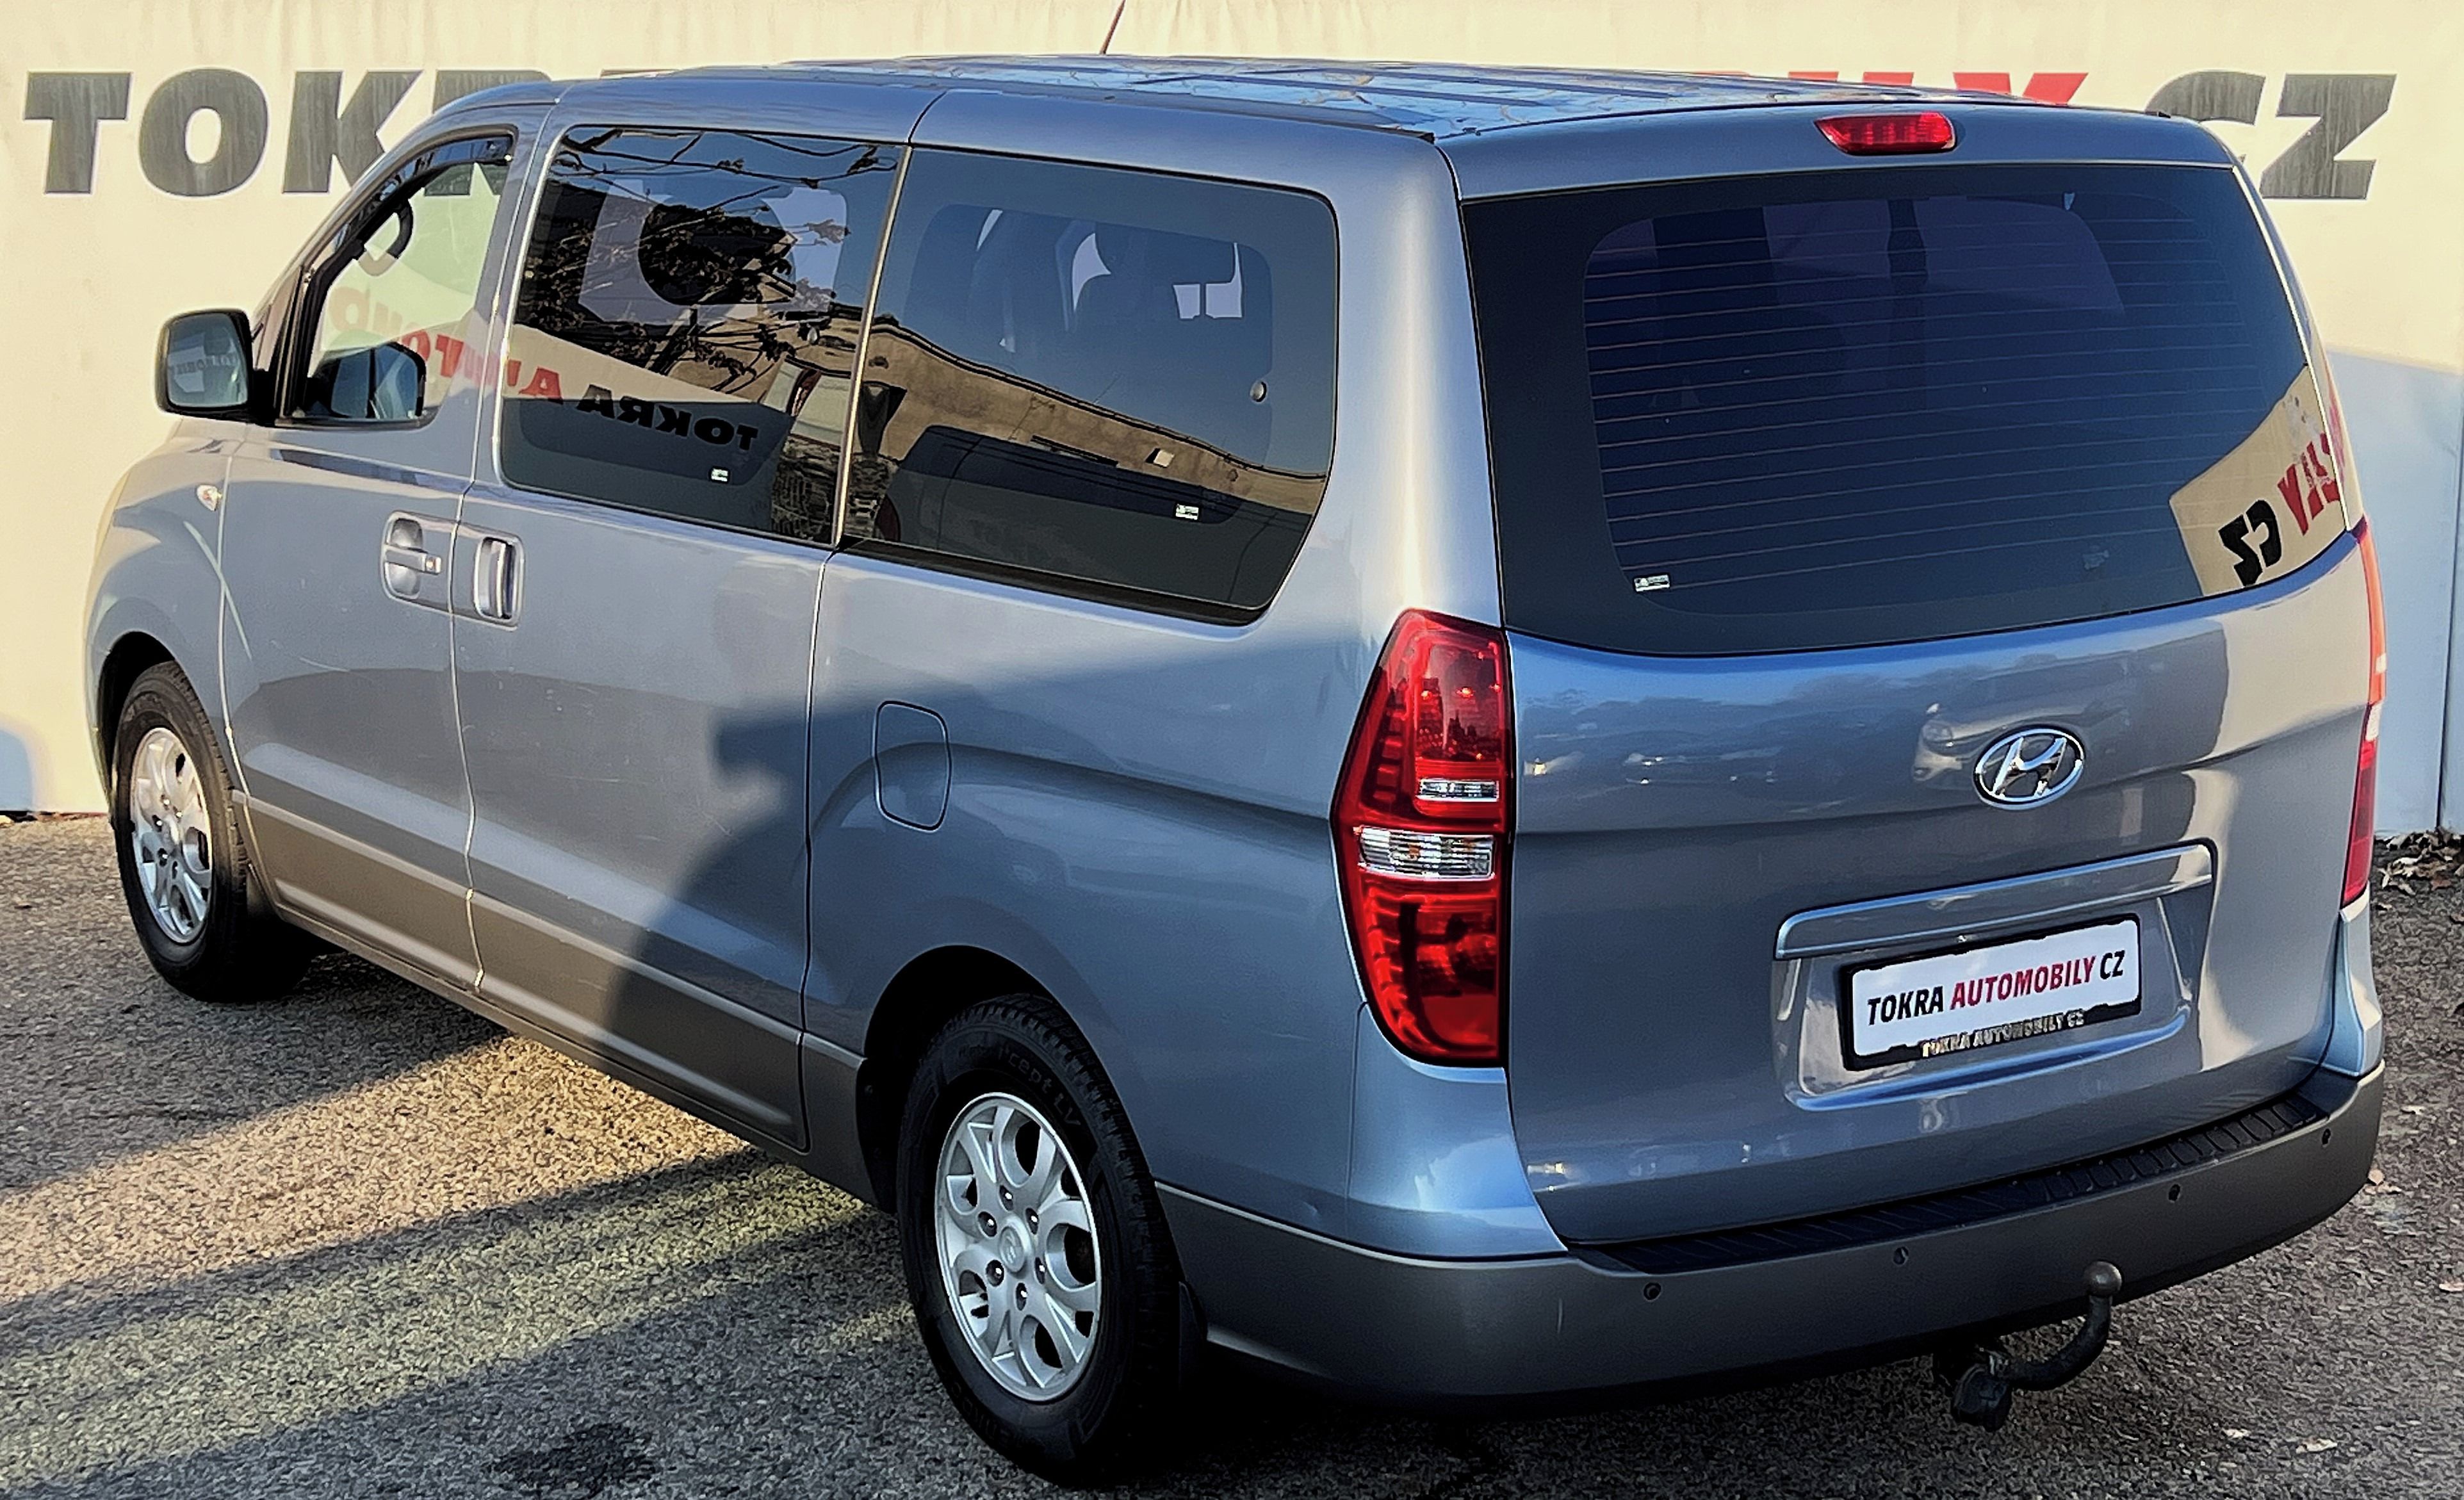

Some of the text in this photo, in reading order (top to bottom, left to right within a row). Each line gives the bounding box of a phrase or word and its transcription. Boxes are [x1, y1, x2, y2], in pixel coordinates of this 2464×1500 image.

[1868, 950, 2125, 1025] TOKRA AUTOMOBILY CZ
